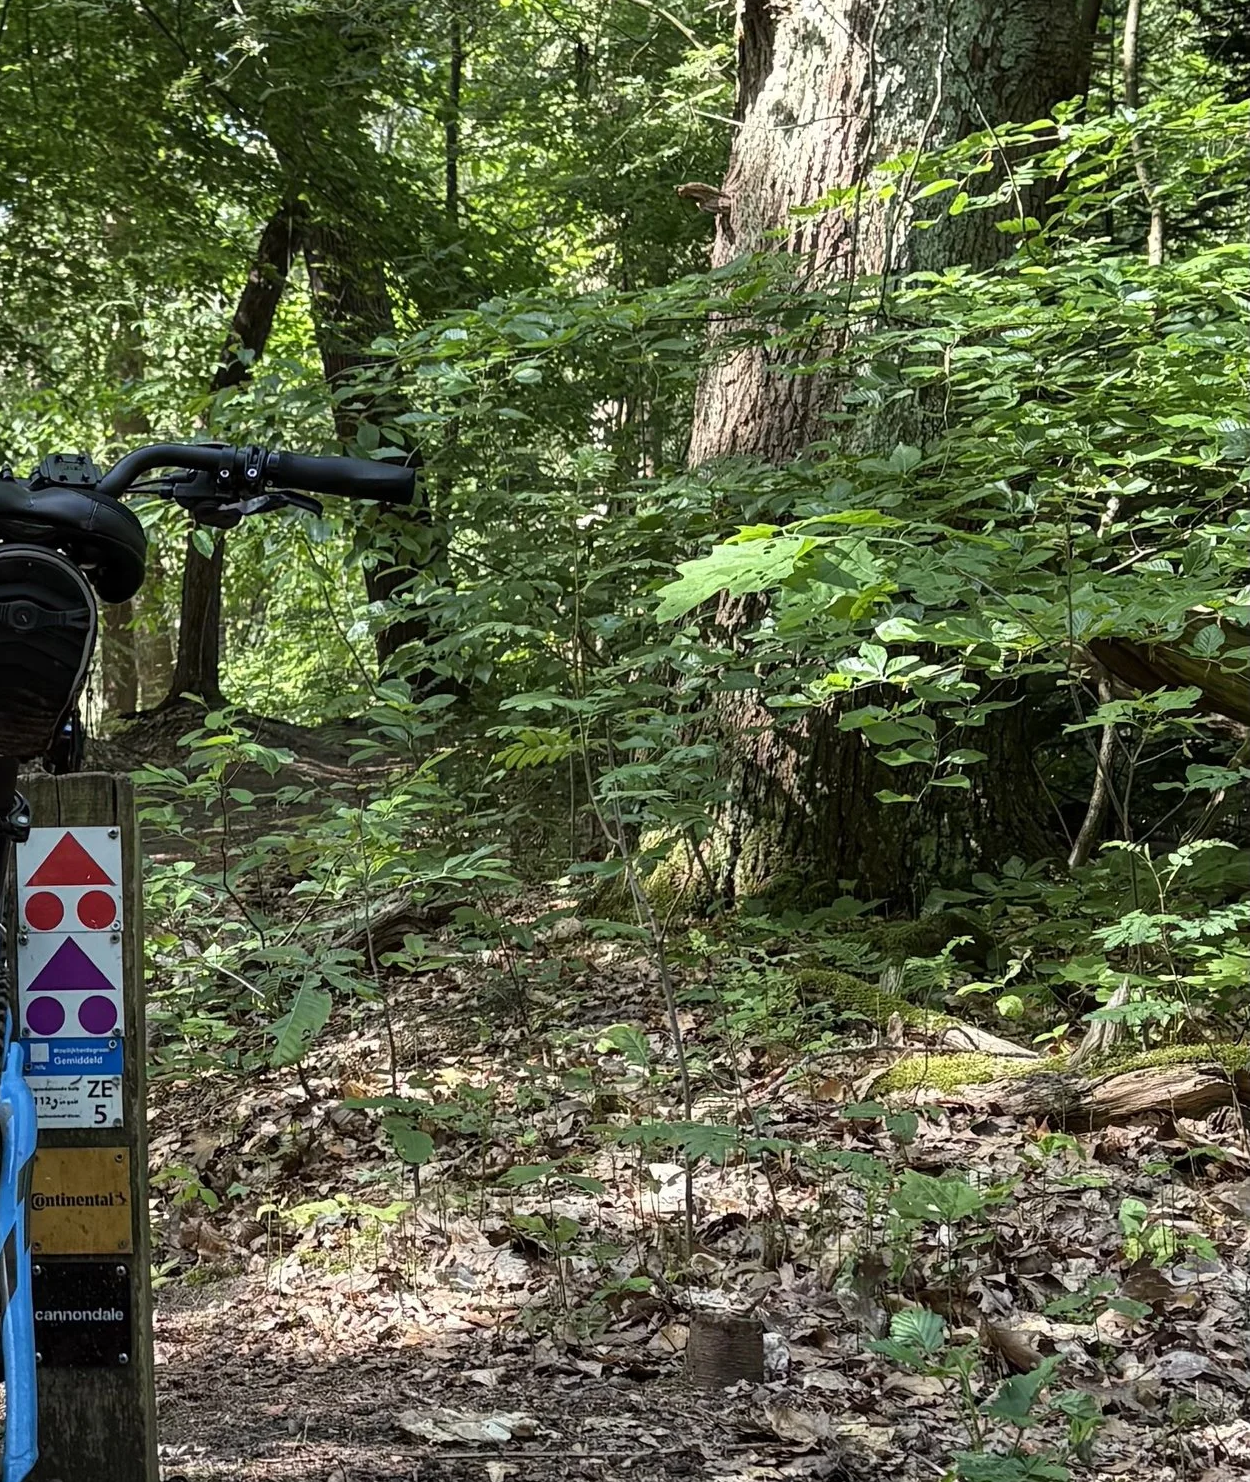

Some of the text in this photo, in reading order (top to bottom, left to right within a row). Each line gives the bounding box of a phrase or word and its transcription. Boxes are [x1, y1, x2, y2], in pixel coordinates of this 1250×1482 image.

[53, 1056, 103, 1065] Gemiddeld
[87, 1080, 113, 1098] ZE
[33, 1096, 52, 1106] 112
[94, 1104, 107, 1124] 5
[32, 1192, 114, 1210] Continental
[34, 1307, 124, 1321] cannondale
